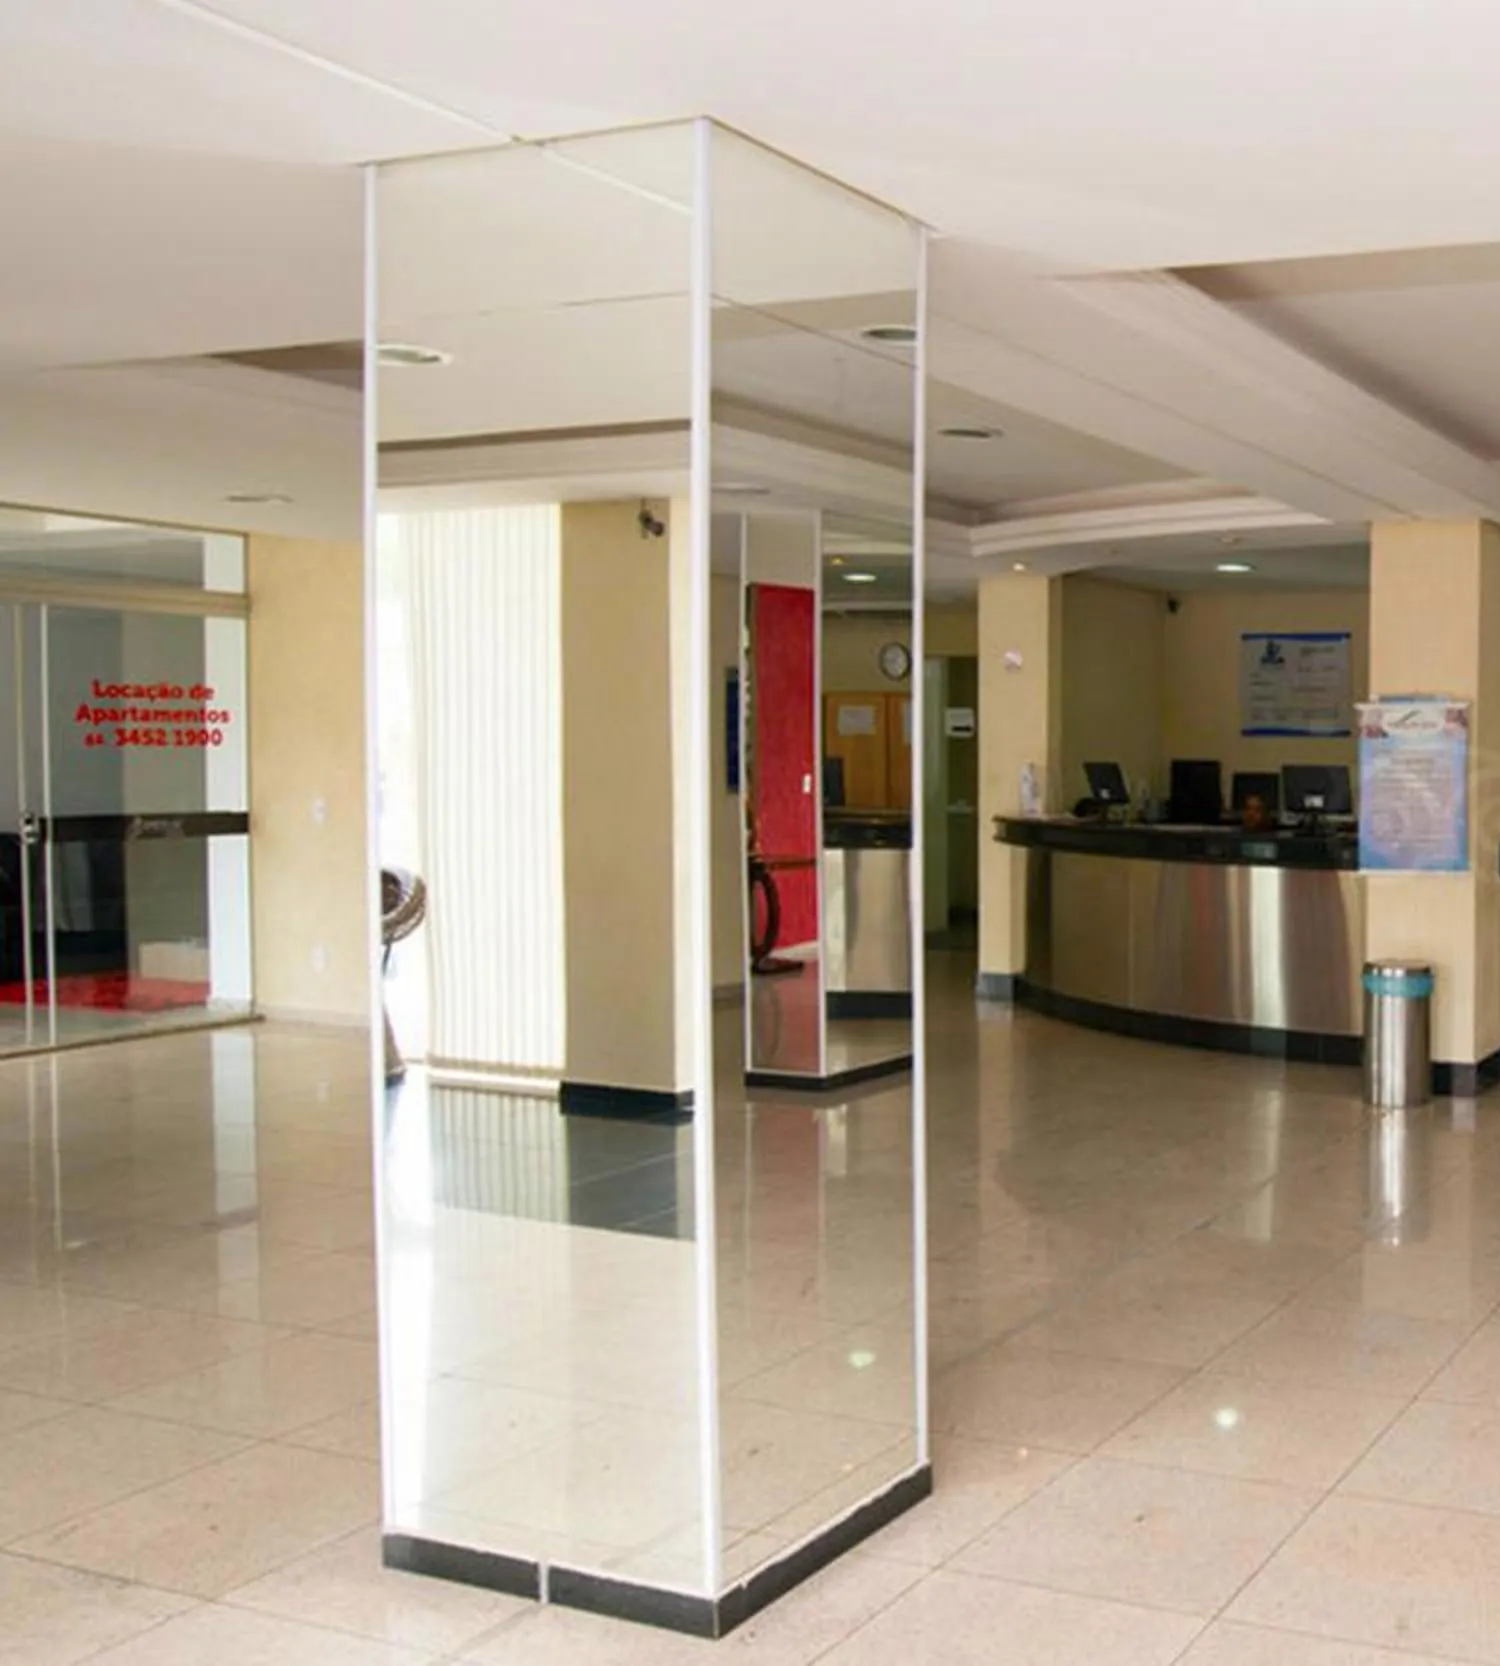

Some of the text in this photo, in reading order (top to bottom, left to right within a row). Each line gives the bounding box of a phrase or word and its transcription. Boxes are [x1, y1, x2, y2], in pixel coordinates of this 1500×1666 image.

[92, 678, 215, 702] Locação de
[75, 703, 230, 727] Apartamentos
[114, 728, 167, 747] 3452
[173, 728, 223, 747] 1900
